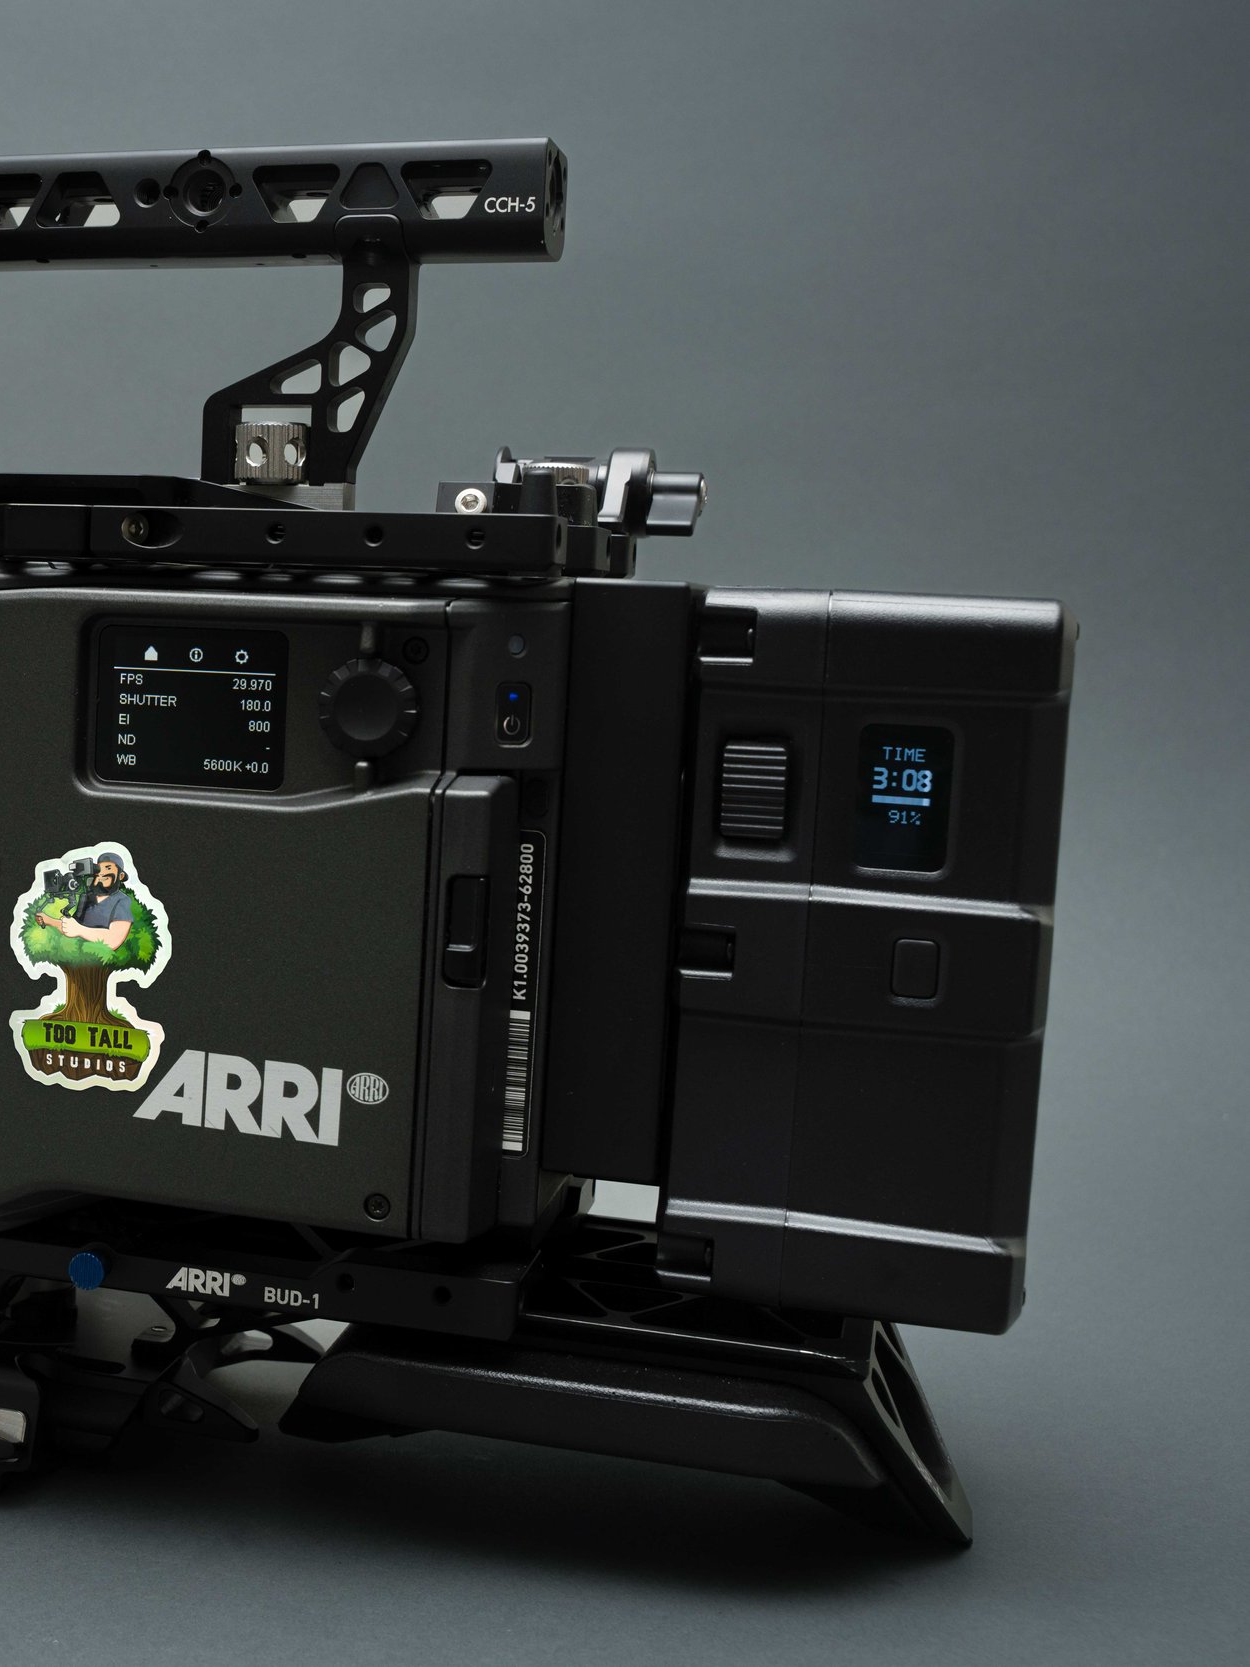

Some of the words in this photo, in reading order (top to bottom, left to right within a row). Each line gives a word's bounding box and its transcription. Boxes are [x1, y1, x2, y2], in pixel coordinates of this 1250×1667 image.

[483, 196, 536, 213] CCH-5
[119, 673, 144, 686] FPS
[231, 677, 273, 692] 29.970
[119, 693, 178, 708] SHUTTER
[239, 699, 272, 712] 180.0
[118, 713, 130, 725] EI
[248, 720, 271, 733] 800
[117, 733, 137, 746] ND
[116, 753, 137, 766] WB
[203, 758, 243, 773] 5600K
[244, 761, 270, 774] +0.0
[882, 746, 927, 763] TIME
[872, 766, 933, 793] 3:08
[888, 809, 922, 826] 91%
[512, 843, 535, 1001] K1.0039373-62800
[43, 1022, 76, 1045] TOO
[88, 1027, 133, 1050] TALL
[46, 1054, 126, 1073] STUDIOS
[132, 1049, 343, 1147] ARRI
[349, 1074, 387, 1103] ARRI
[165, 1266, 231, 1298] ARRI
[263, 1286, 320, 1310] BUD-1
